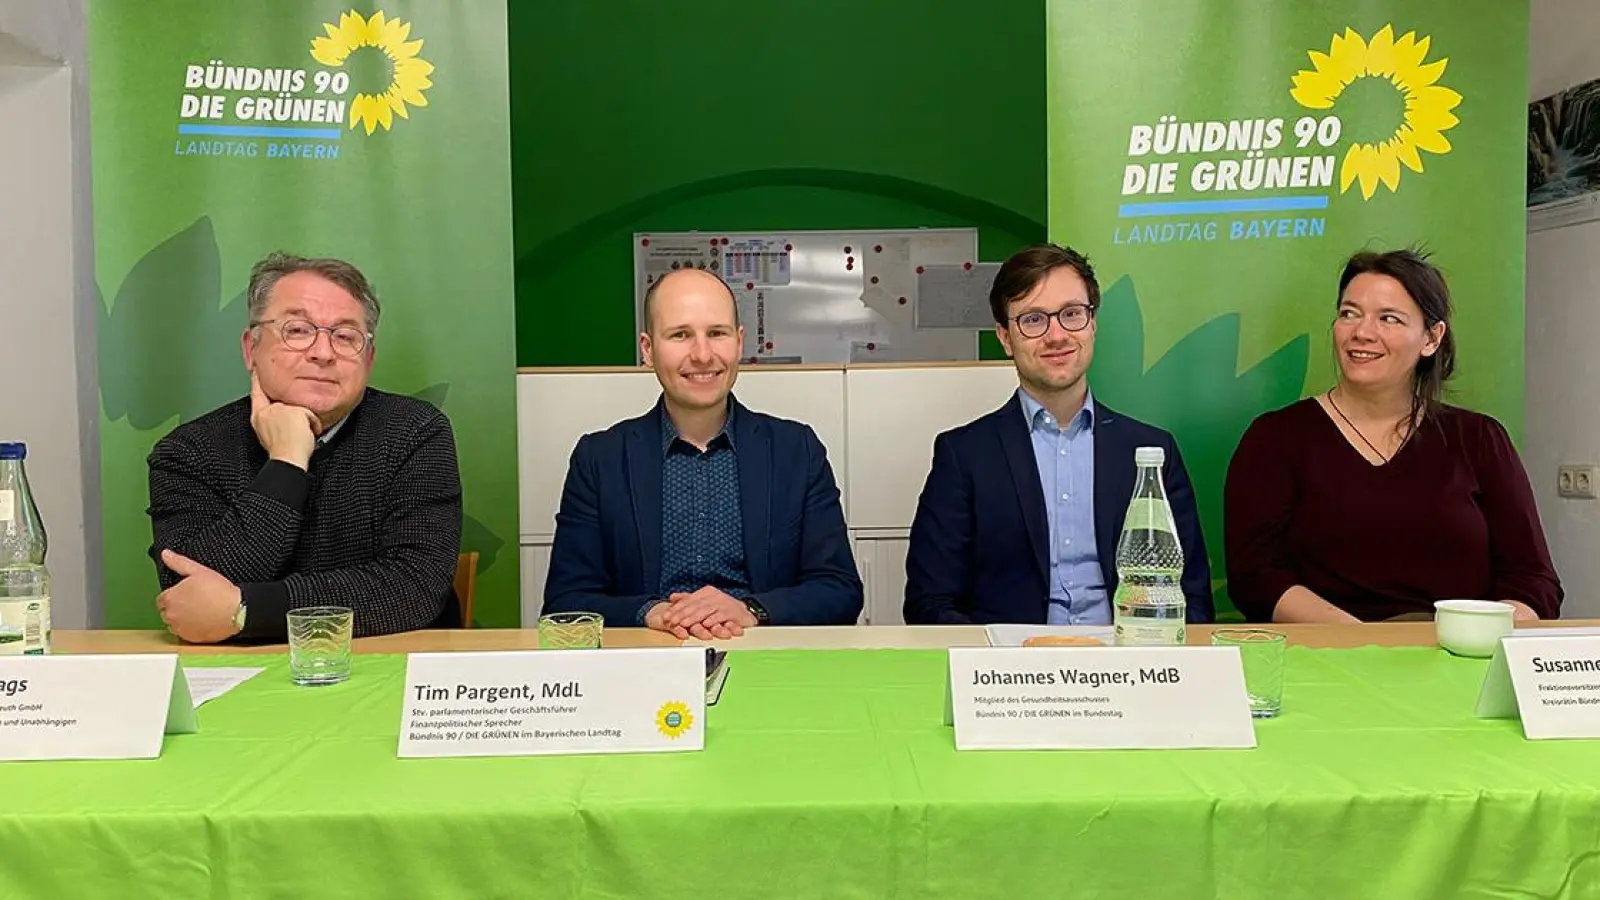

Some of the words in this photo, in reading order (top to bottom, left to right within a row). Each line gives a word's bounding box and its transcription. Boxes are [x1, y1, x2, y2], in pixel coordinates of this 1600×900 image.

[185, 60, 306, 92] BÜNDNIS
[313, 71, 350, 94] 90
[180, 95, 225, 118] DIE
[235, 93, 346, 123] GRÜNEN
[1128, 115, 1283, 156] BÜNDNIS
[1294, 116, 1342, 148] 90
[174, 140, 258, 157] LANDTAG
[266, 143, 340, 159] BAYERN
[1121, 162, 1179, 195] DIE
[1191, 150, 1335, 191] GRÜNEN
[1113, 221, 1217, 245] LANDTAG
[1229, 217, 1326, 239] BAYERN
[1532, 656, 1600, 673] Susanne
[972, 669, 1055, 685] Johannes
[1059, 668, 1136, 688] Wagner,
[1140, 667, 1181, 684] MdB
[415, 685, 449, 701] Tim
[456, 684, 535, 703] Pargent,
[541, 682, 584, 698] MdL
[412, 708, 427, 717] Stv.
[429, 706, 508, 717] parlamentarischer
[509, 705, 578, 714] Geschäftsführer
[975, 709, 1006, 718] Bündnis
[1007, 710, 1018, 718] 90
[1039, 708, 1071, 718] GRÜNEN
[1083, 709, 1123, 718] Bundestag
[410, 719, 483, 729] Finanzpolitischer
[484, 718, 523, 729] Sprecher
[409, 731, 444, 741] Bündnis
[445, 731, 458, 740] 90
[465, 730, 480, 739] DIE
[481, 728, 520, 739] GRÜNEN
[521, 730, 533, 738] im
[534, 729, 587, 739] Bayerischen
[588, 728, 622, 738] Landtag
